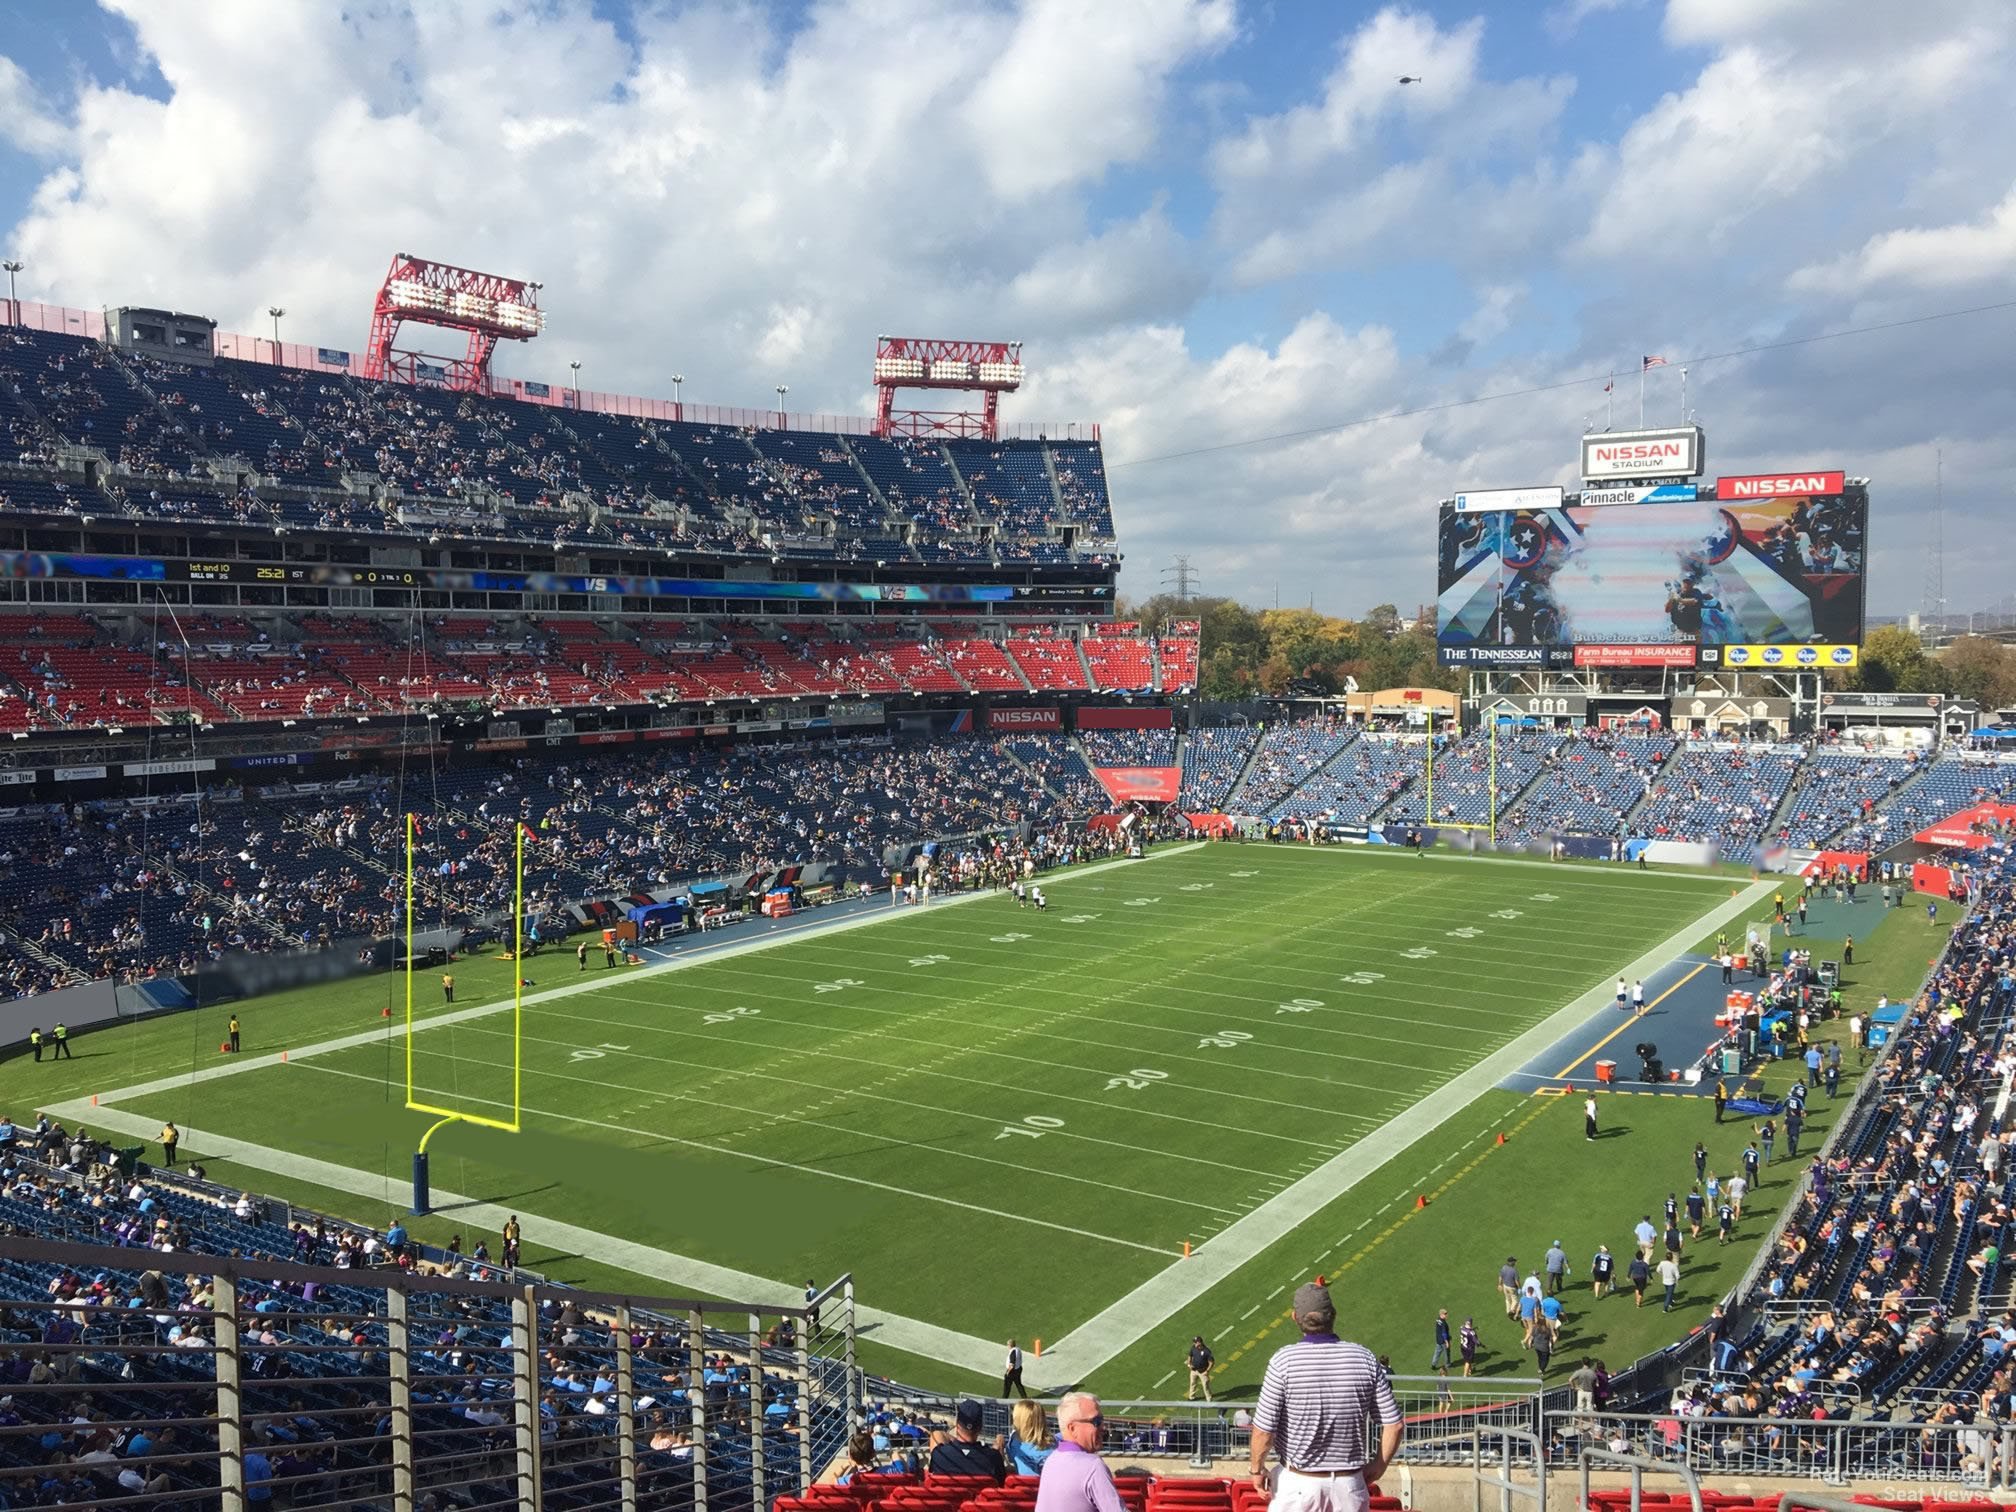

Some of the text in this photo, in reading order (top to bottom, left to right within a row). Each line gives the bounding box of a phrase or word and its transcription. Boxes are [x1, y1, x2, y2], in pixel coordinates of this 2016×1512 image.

[1597, 444, 1680, 461] NISSAN
[1612, 460, 1663, 469] STADIUM
[1734, 477, 1825, 495] NISSAN
[1583, 491, 1635, 504] Pinnacle
[257, 568, 285, 578] 25:21
[368, 572, 377, 582] 0
[403, 574, 412, 583] 0
[584, 578, 607, 591] VS
[879, 586, 906, 600] VS
[1443, 648, 1542, 660] THE TENNESSEAN
[1577, 647, 1691, 656] Farm Bureau INSURANCE
[993, 711, 1056, 723] NISSAN
[248, 757, 286, 765] UNITED
[18, 774, 33, 783] Lite
[1931, 836, 1967, 847] NISSAN
[1197, 1031, 1253, 1049] 30
[1103, 1069, 1169, 1091] 20
[994, 1115, 1065, 1141] 10
[1600, 1260, 1608, 1272] 9
